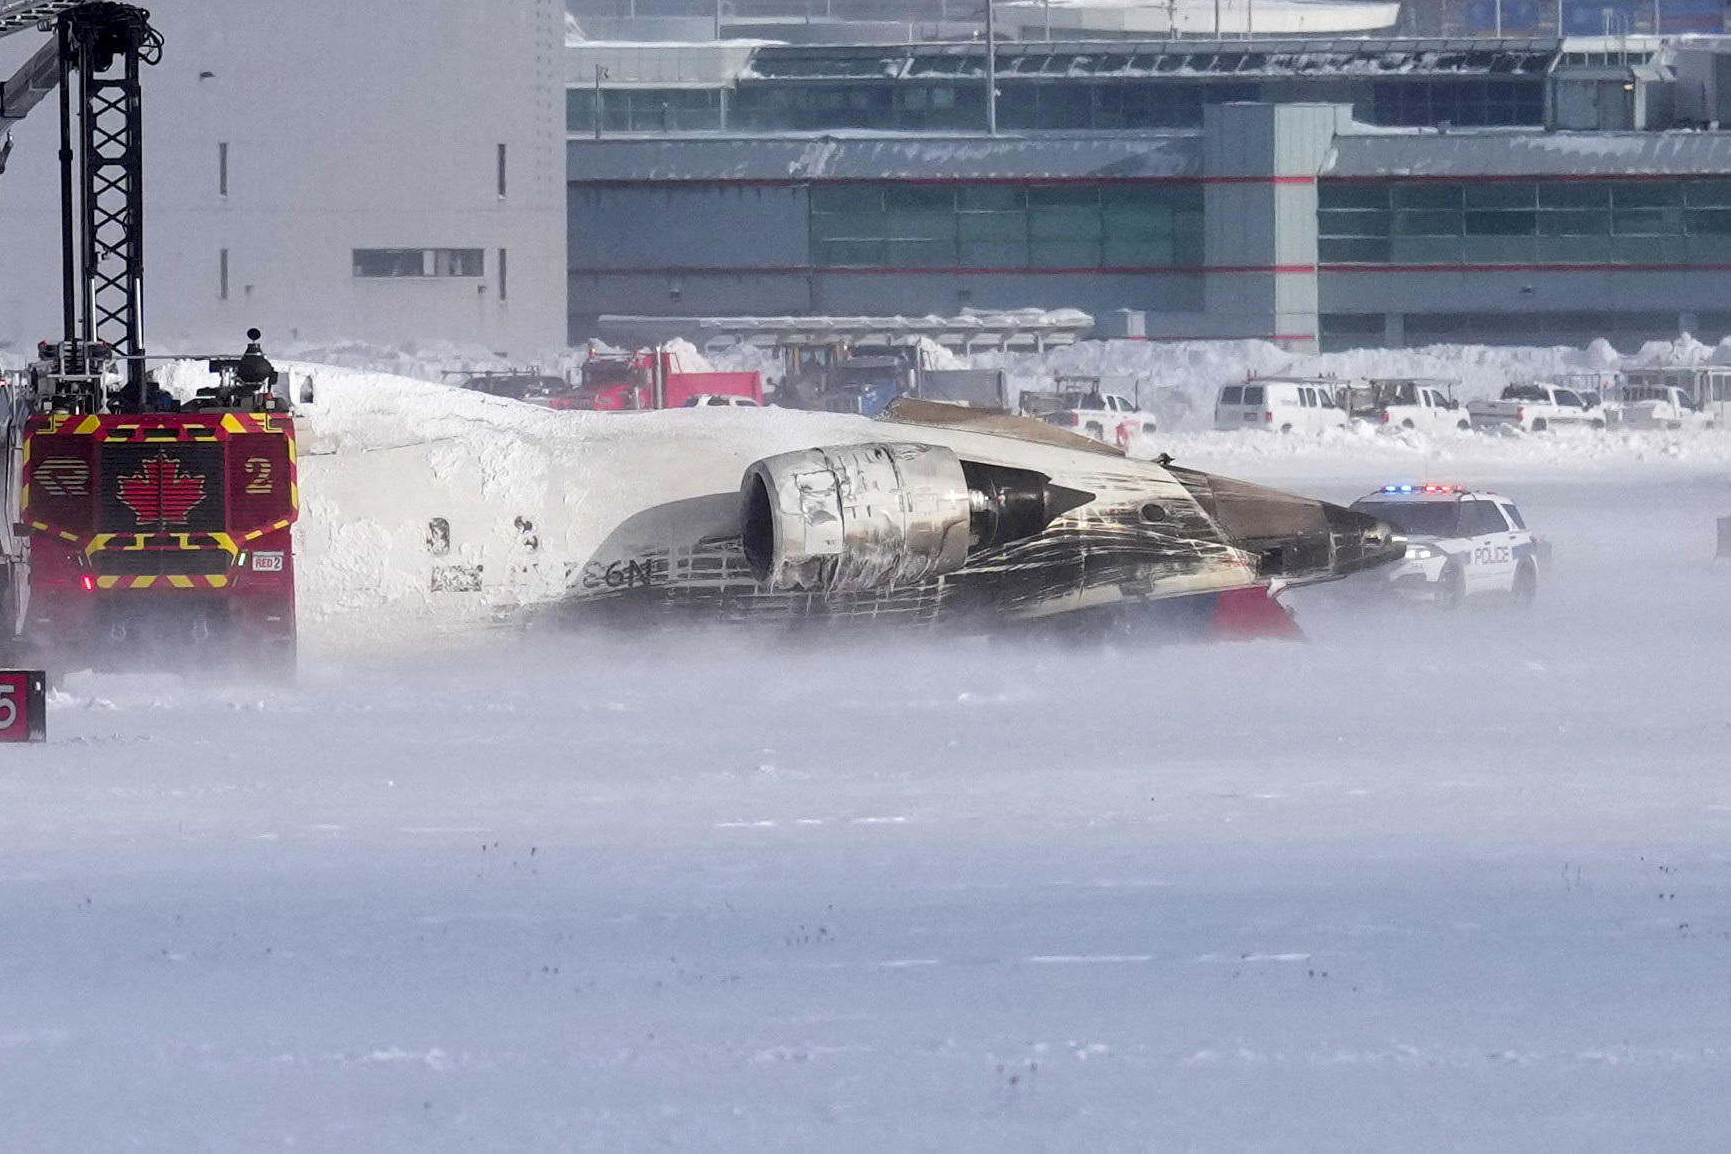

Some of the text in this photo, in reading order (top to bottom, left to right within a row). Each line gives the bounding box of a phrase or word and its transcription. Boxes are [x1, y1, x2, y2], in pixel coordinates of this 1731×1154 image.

[244, 457, 273, 494] 2
[256, 556, 281, 569] RED 2
[1474, 546, 1510, 565] POLICE
